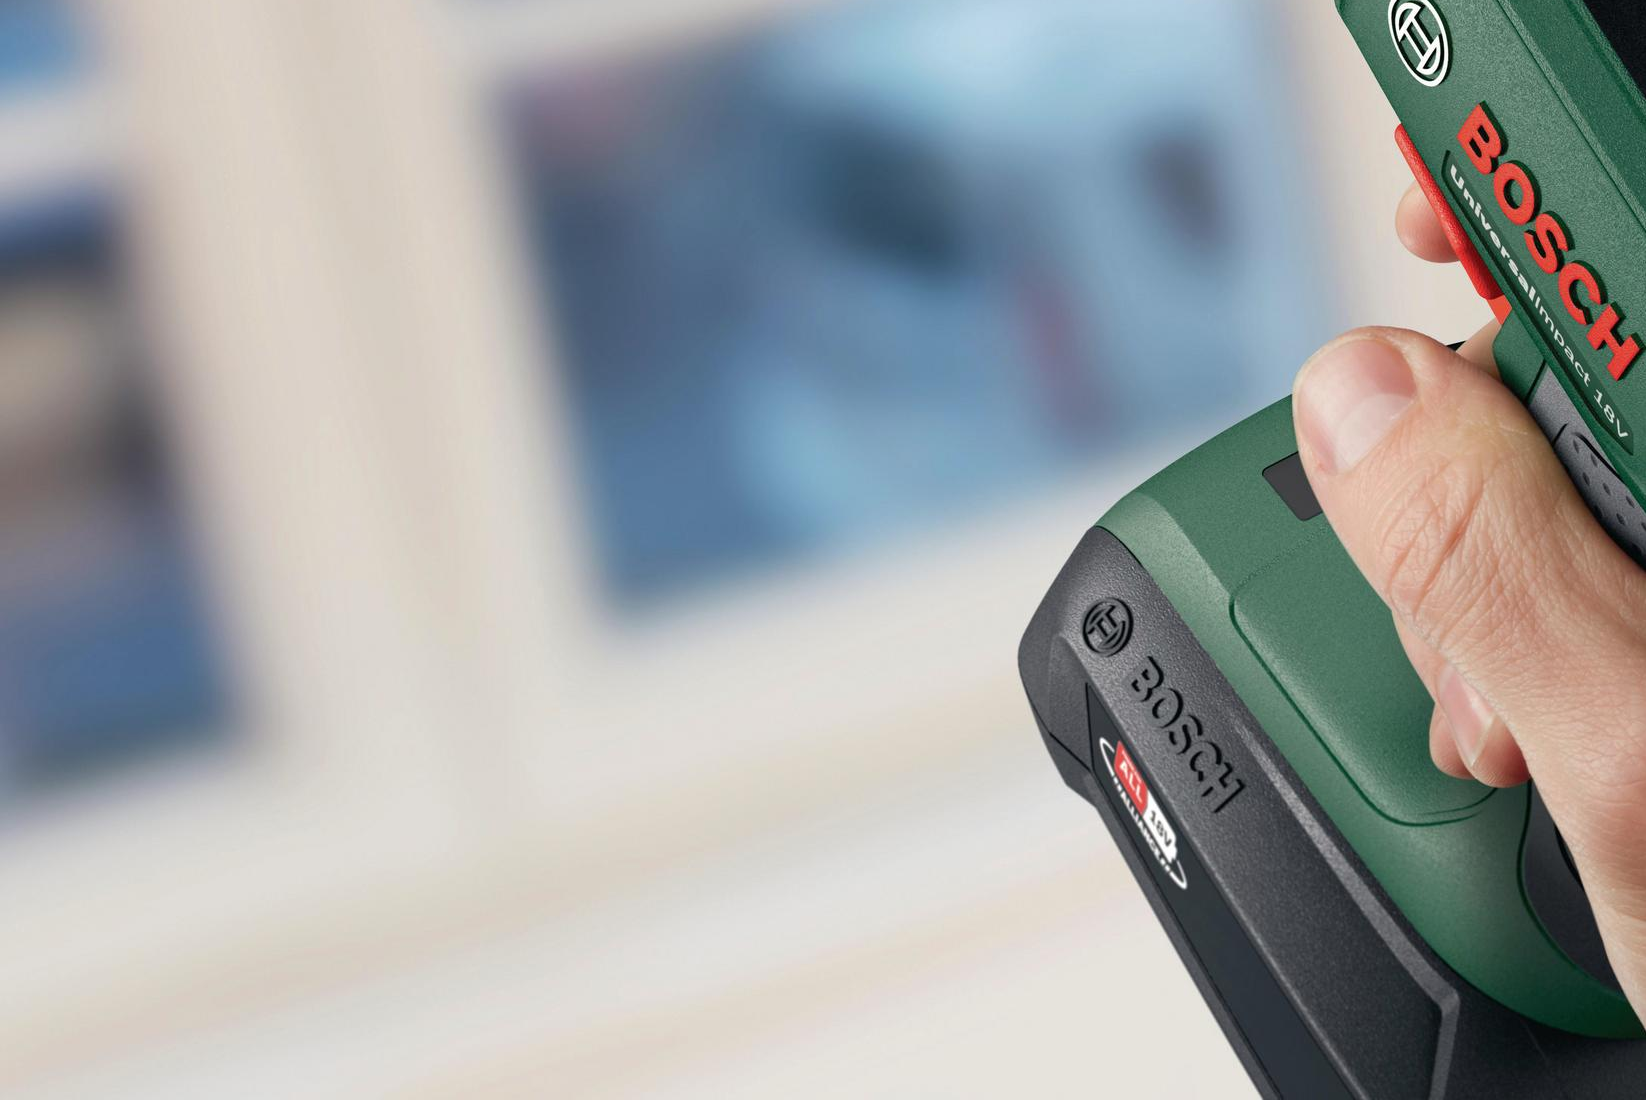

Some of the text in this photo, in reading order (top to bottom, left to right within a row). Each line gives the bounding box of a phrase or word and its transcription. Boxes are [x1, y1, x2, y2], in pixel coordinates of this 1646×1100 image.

[1450, 164, 1629, 439] UniversalImpact 18V
[1457, 102, 1643, 381] BOSCH
[1120, 760, 1143, 804] ALL
[1128, 656, 1246, 813] BOSCH
[1150, 810, 1172, 847] 18V
